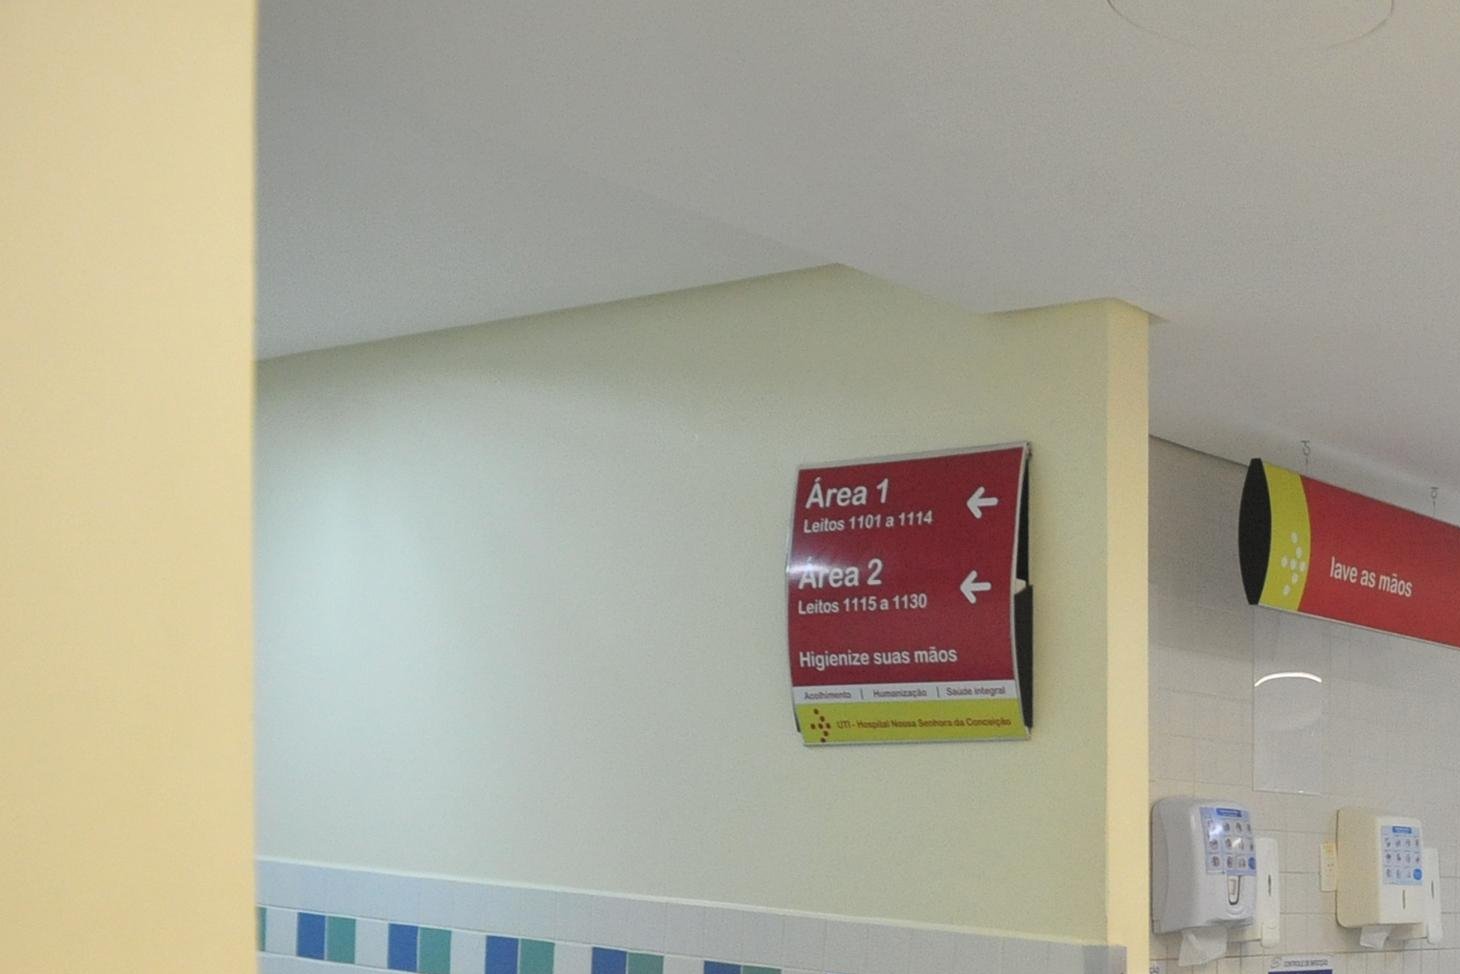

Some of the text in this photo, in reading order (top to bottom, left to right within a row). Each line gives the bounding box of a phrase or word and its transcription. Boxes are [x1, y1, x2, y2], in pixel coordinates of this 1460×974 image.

[805, 477, 889, 509] Área 1
[804, 510, 933, 533] Leitos 1101 a 1114
[798, 556, 883, 589] Área 2
[1329, 556, 1413, 598] lave as mãos
[798, 593, 928, 615] Leitos 1115 a 1130
[799, 646, 957, 672] Higienize suas mãos
[872, 688, 928, 699] Humanização
[974, 685, 1006, 697] integral
[837, 720, 851, 729] UTI
[857, 719, 888, 729] Hospital
